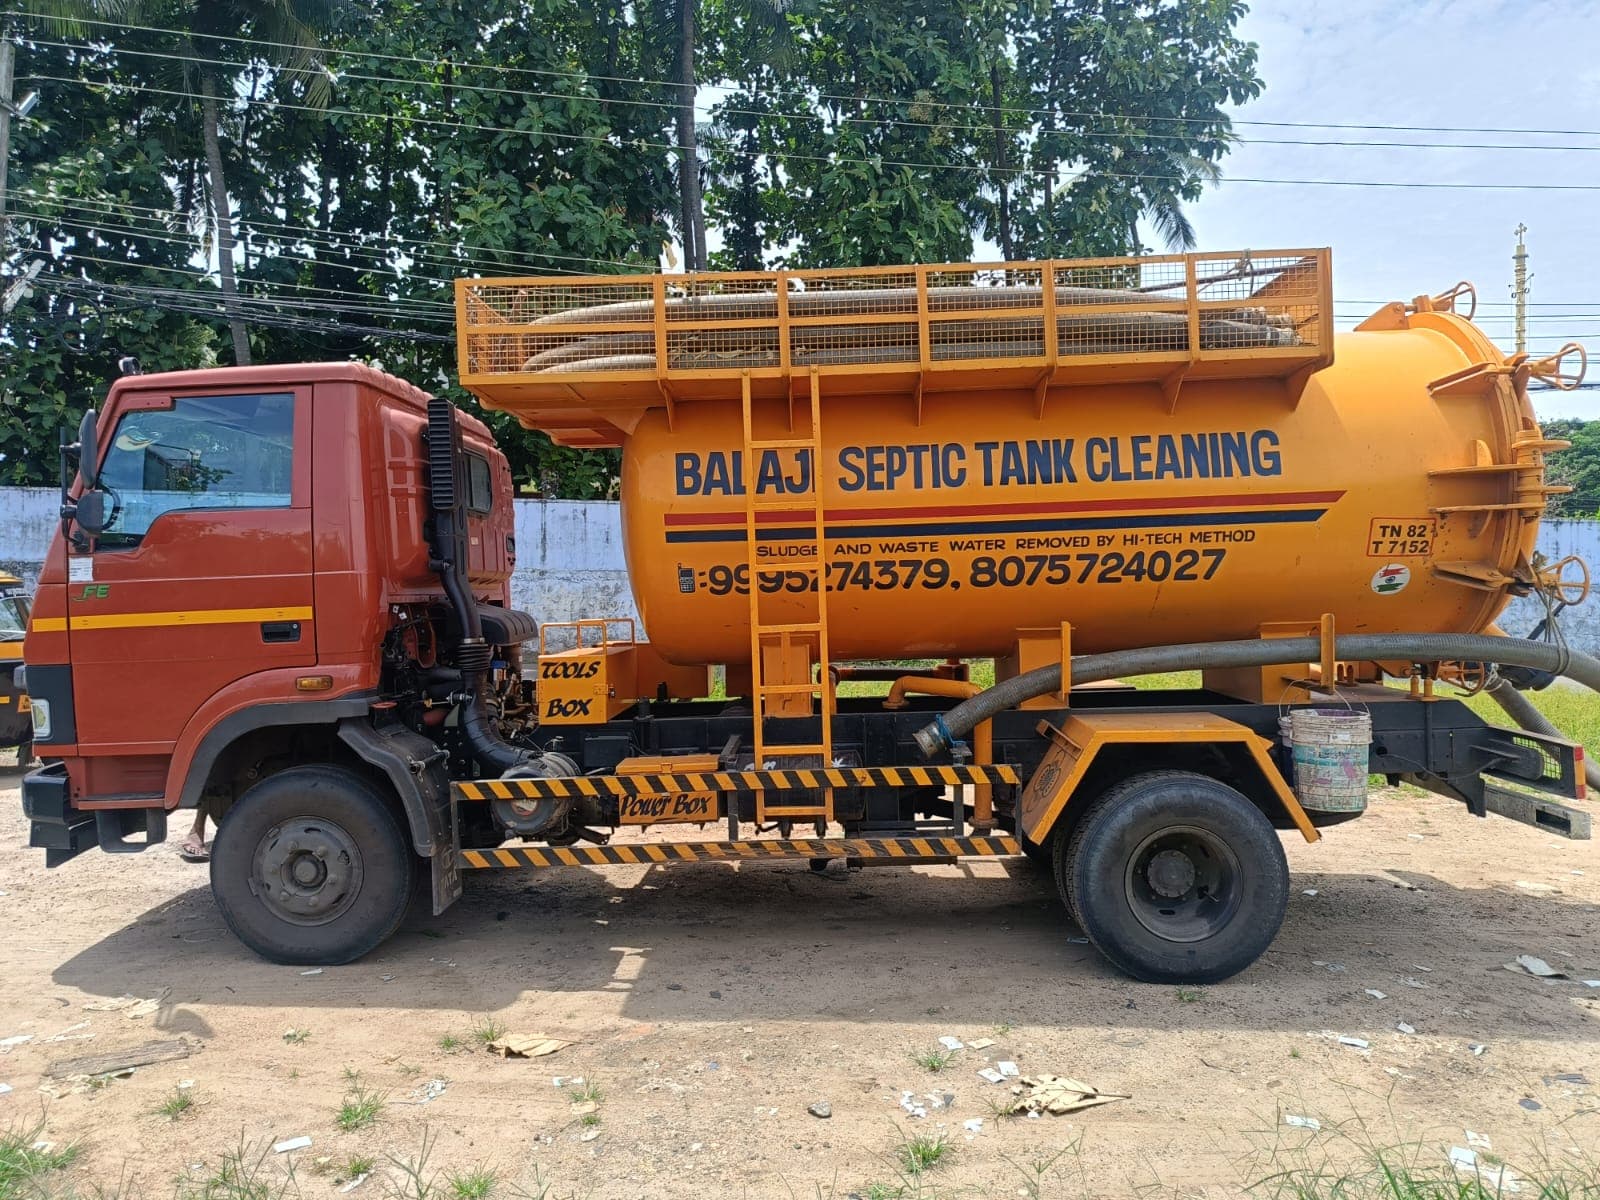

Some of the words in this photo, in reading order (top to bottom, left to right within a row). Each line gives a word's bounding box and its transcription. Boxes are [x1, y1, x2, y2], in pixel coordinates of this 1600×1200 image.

[837, 443, 967, 492] SEPTIC
[975, 438, 1077, 487] TANK
[1085, 430, 1282, 483] CLEANING
[1379, 525, 1402, 538] TN
[1407, 525, 1427, 538] 82
[756, 545, 817, 557] SLUDGE
[834, 543, 872, 555] AND
[879, 541, 939, 553] WASTE
[950, 539, 1006, 551] WATER
[1016, 536, 1090, 550] REMOVED
[1096, 535, 1115, 547] BY
[1123, 532, 1182, 546] HI-TECH
[1190, 530, 1255, 544] METHOD
[1372, 540, 1383, 553] T
[1388, 540, 1429, 553] 7152
[970, 549, 1226, 588] 8075724027
[541, 661, 601, 679] TOOLS
